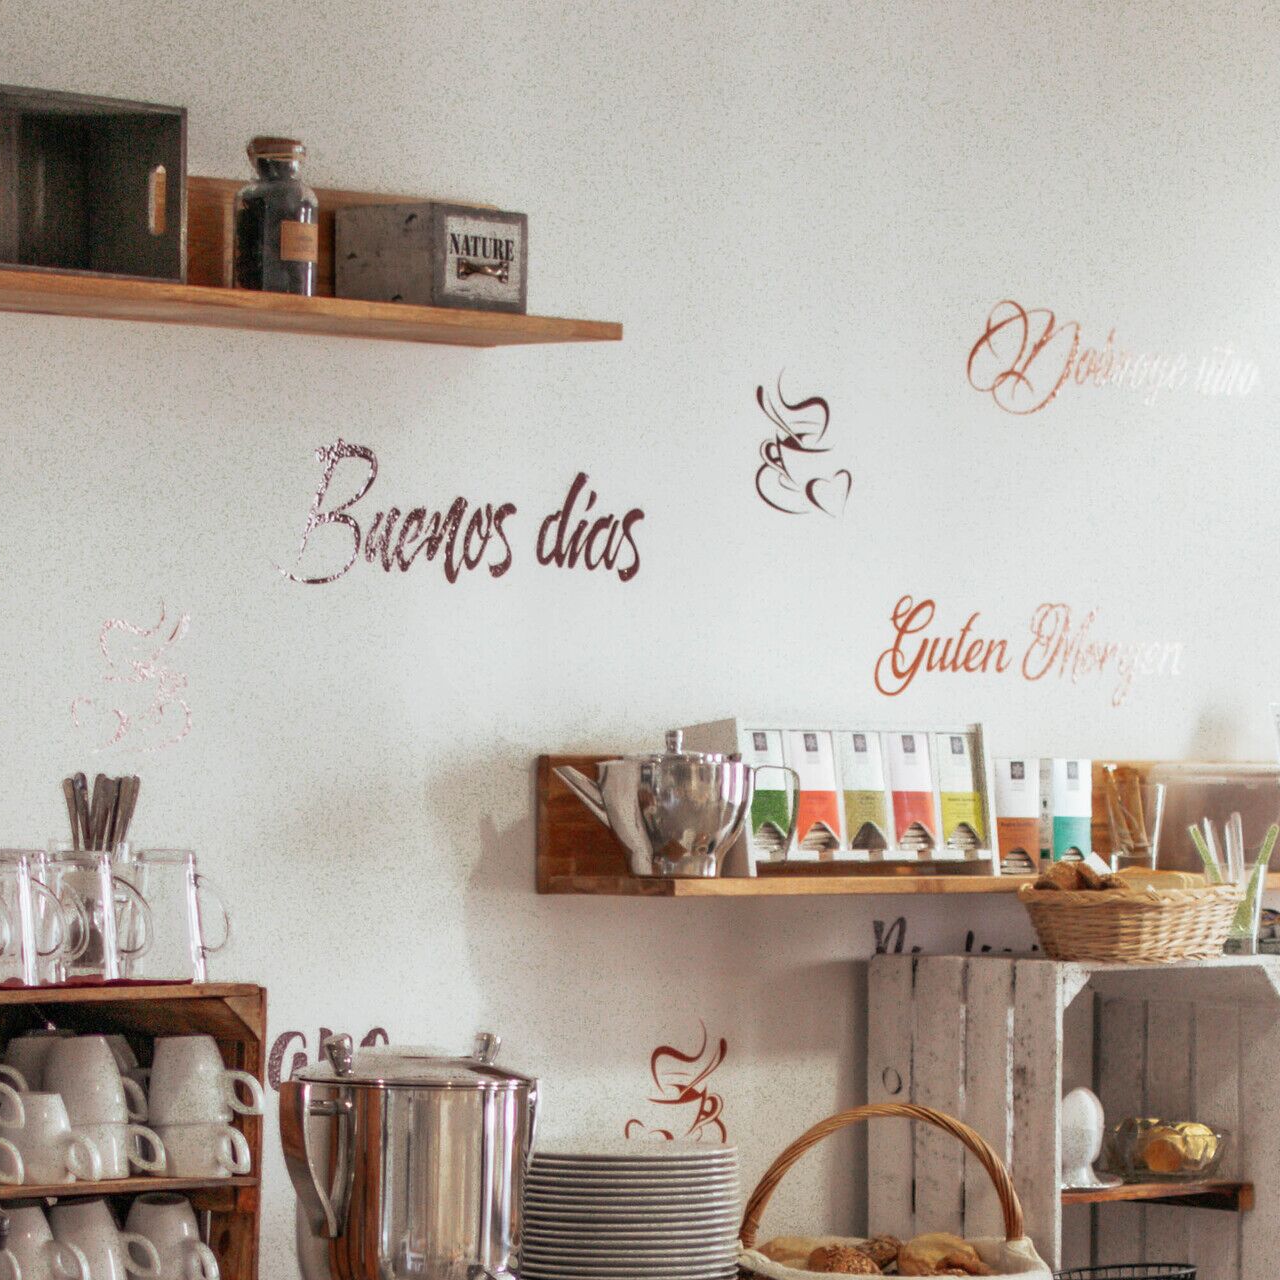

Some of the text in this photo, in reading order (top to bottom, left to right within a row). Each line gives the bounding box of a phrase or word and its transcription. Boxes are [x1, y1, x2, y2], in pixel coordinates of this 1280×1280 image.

[449, 232, 514, 262] NATURE
[270, 438, 517, 585] Buenos
[874, 595, 1185, 707] Guten Morgen
